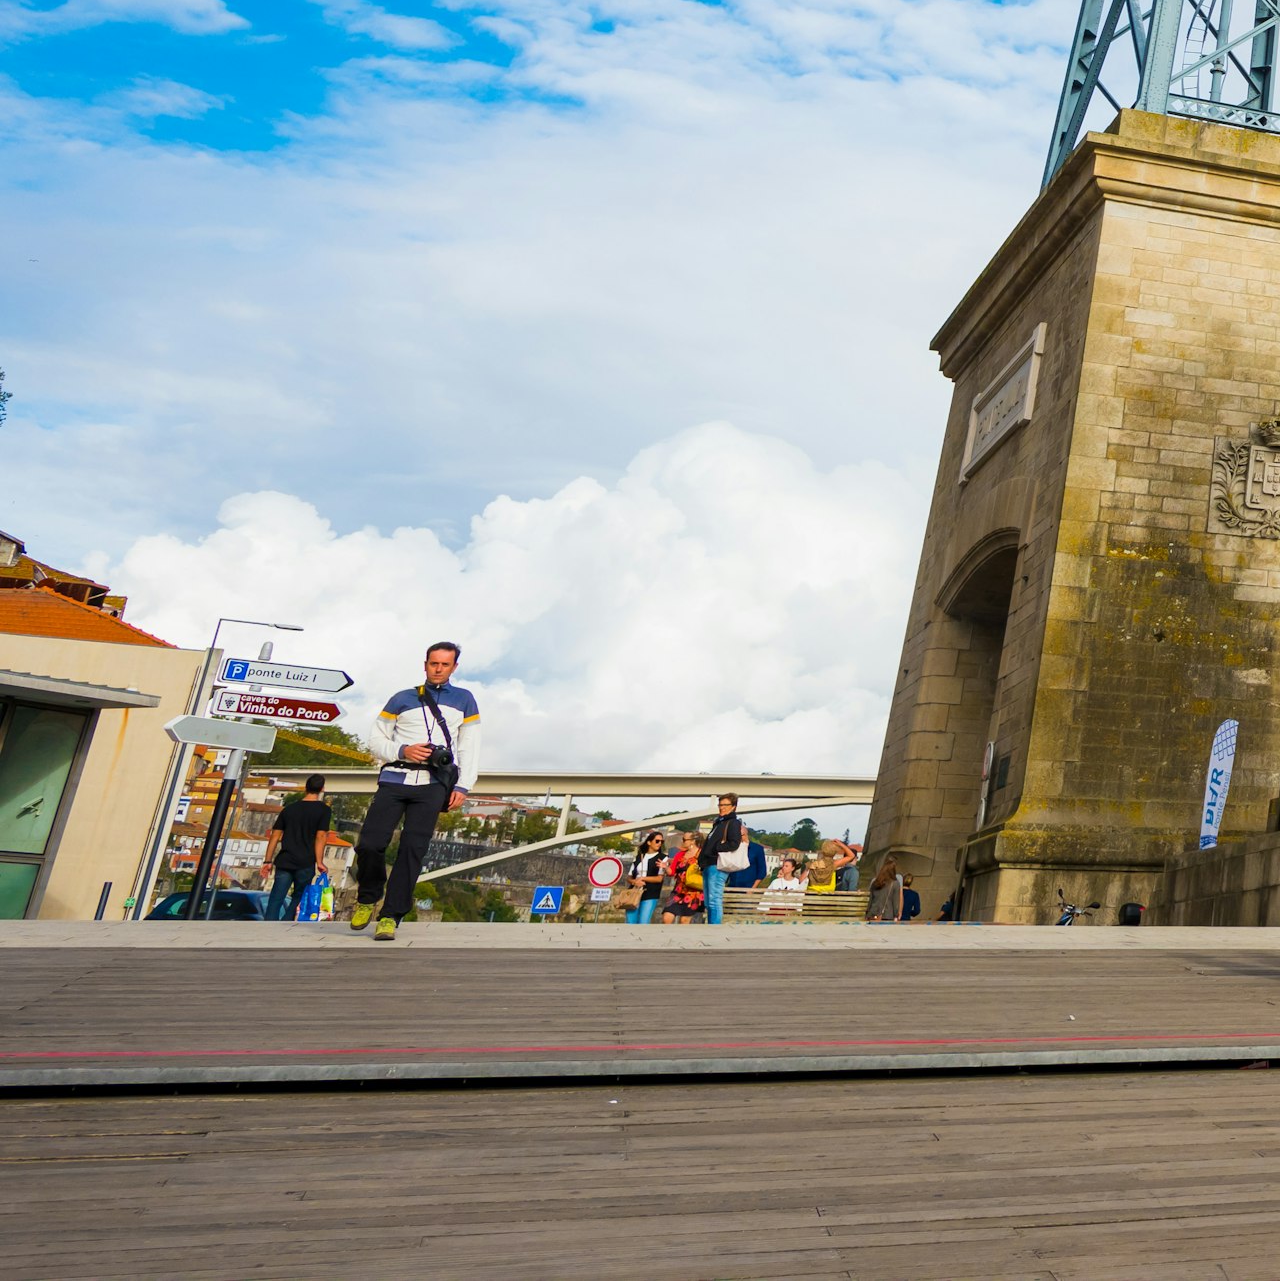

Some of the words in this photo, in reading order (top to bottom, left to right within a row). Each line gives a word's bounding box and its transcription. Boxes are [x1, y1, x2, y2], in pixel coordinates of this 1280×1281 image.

[247, 667, 282, 679] ponte
[286, 670, 309, 683] Luiz
[240, 694, 267, 704] caves
[268, 697, 280, 705] do
[239, 701, 275, 715] Vinho
[277, 705, 294, 717] do
[296, 707, 330, 721] Porto
